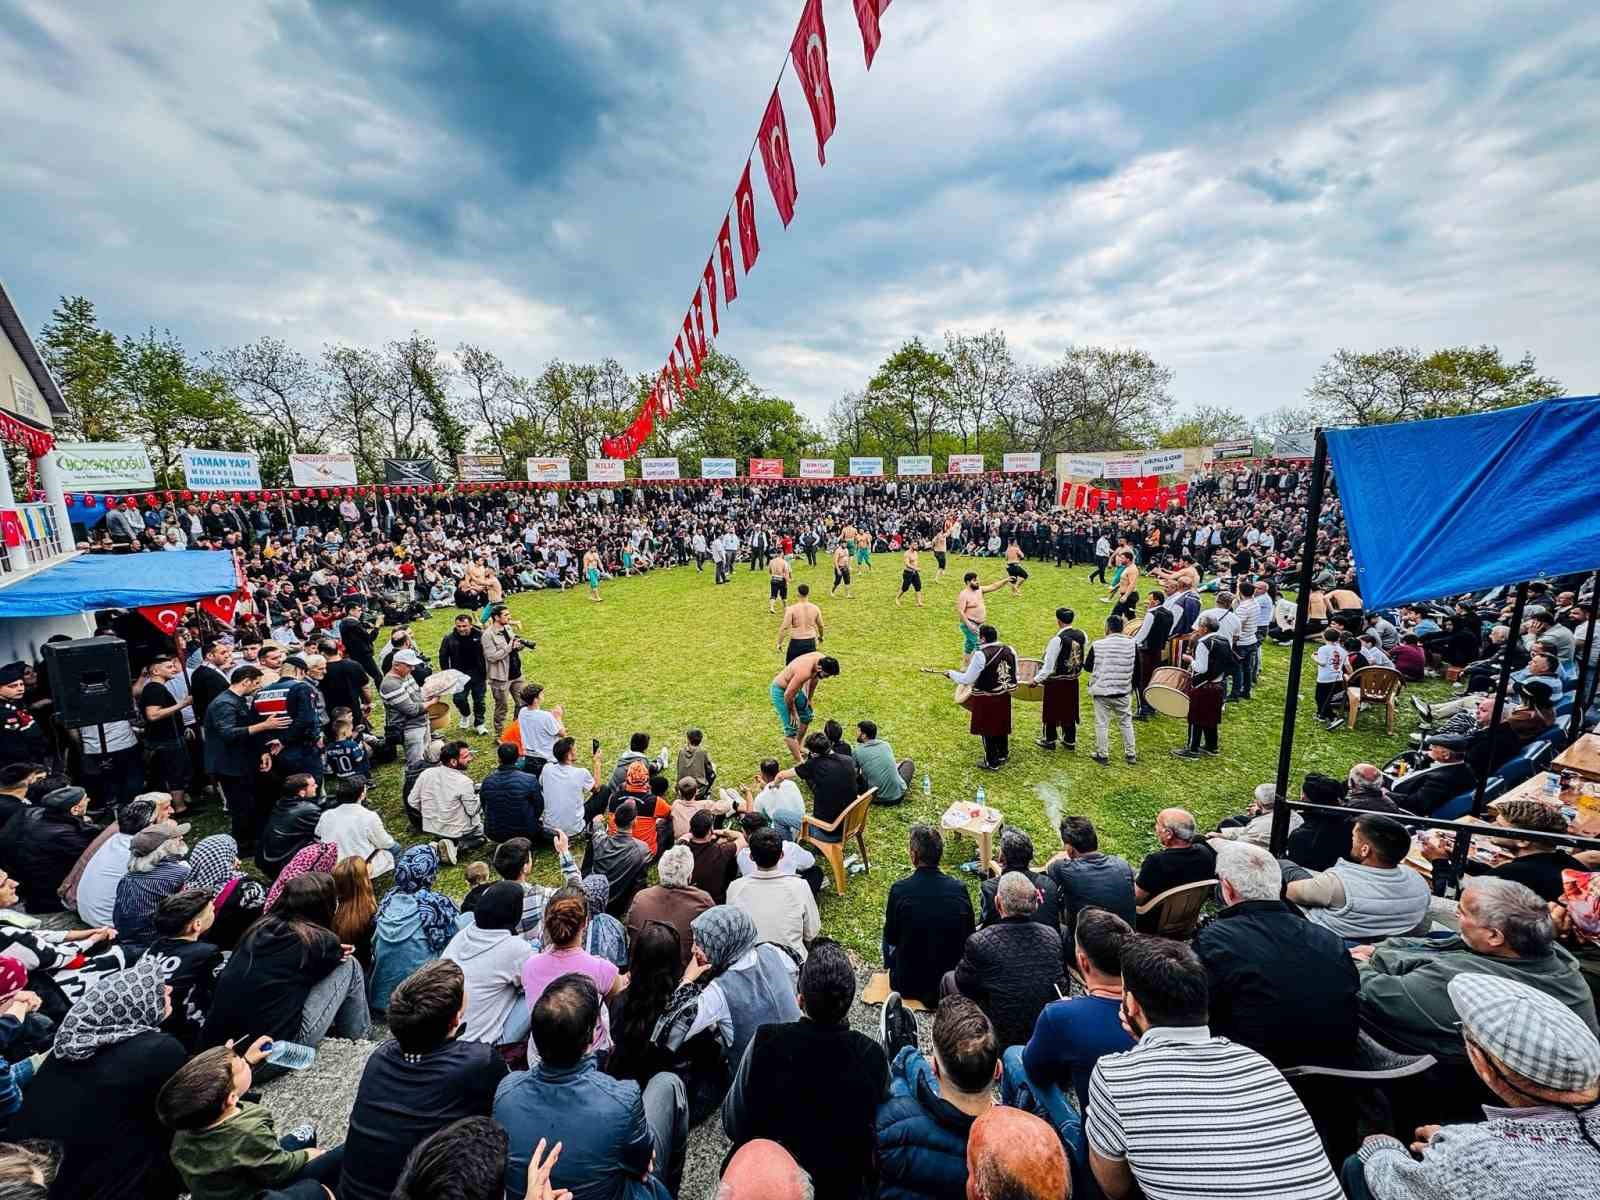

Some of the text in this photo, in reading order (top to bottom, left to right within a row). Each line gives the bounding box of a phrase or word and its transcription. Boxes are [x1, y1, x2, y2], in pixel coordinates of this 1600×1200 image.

[190, 456, 250, 469] YAMAN YAPI
[190, 477, 230, 486] ABDULLAH
[331, 755, 353, 773] 10
